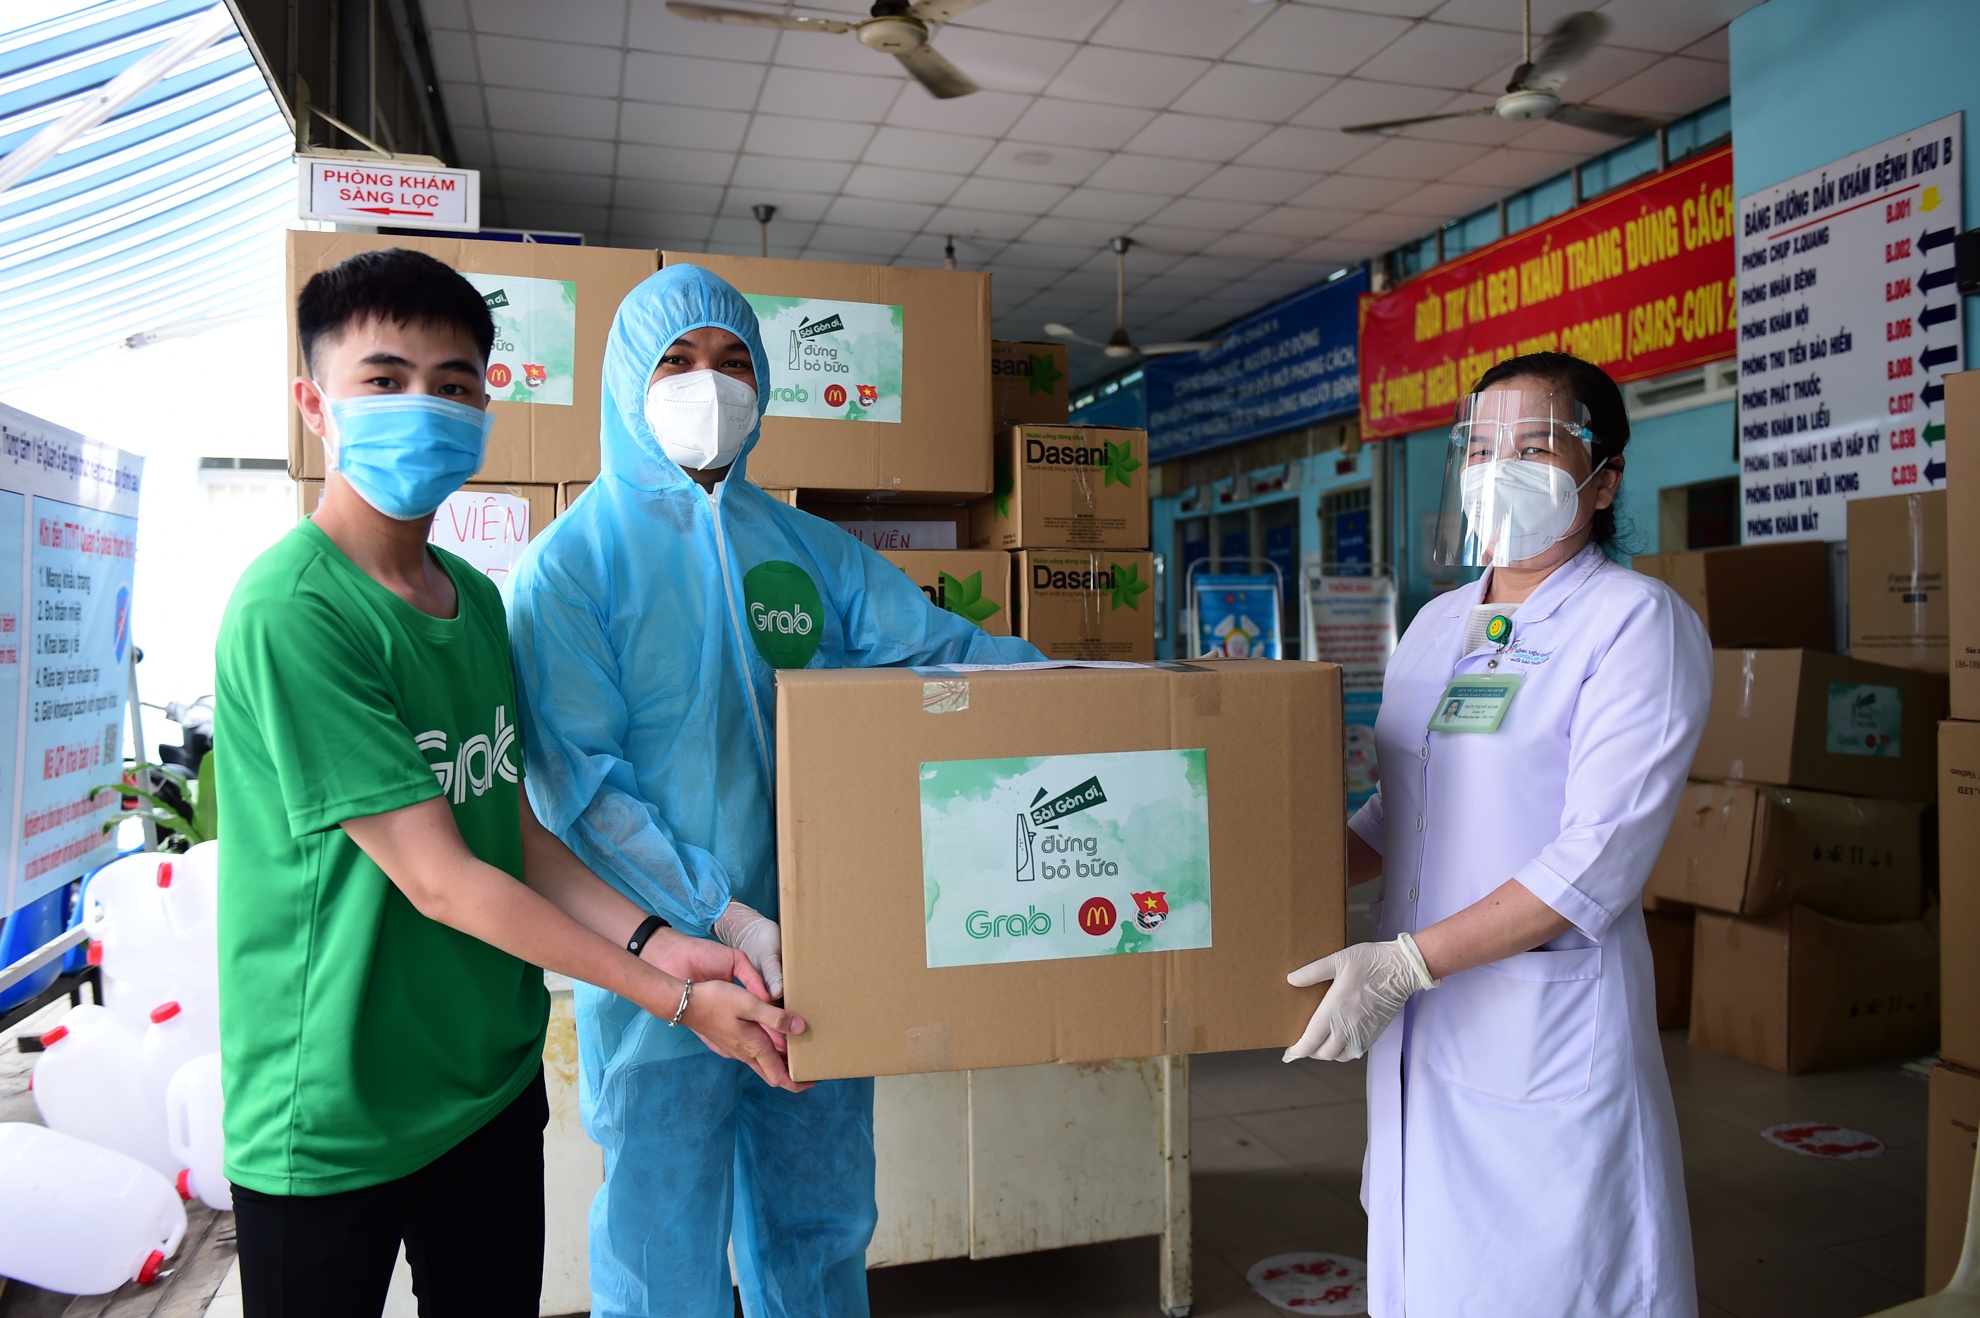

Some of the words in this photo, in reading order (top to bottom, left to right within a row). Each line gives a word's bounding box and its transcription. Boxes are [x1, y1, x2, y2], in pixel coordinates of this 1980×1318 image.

[324, 166, 394, 187] PHÒNG
[400, 173, 456, 191] KHÁM
[1745, 202, 1771, 238] BẢNG
[1813, 172, 1835, 212] DẪN
[1839, 164, 1871, 202] KHÁM
[1875, 153, 1907, 191] BỆNH
[1912, 140, 1939, 176] KHU
[1943, 136, 1953, 165] B
[339, 185, 394, 204] SÀNG
[401, 193, 440, 210] LỌC
[1487, 264, 1518, 318] ĐEO
[1520, 235, 1563, 308] KHẨU
[1565, 227, 1622, 293] TRANG
[1625, 204, 1679, 272] ĐÚNG
[1683, 181, 1735, 252] CÁCH
[1742, 249, 1767, 272] PHÒNG
[1770, 240, 1790, 265] CHỤP
[1886, 197, 1911, 224] B.001
[1742, 284, 1767, 307] PHÒNG
[1795, 267, 1817, 295] BỆNH
[1886, 238, 1911, 263] B.002
[1742, 317, 1767, 340] PHÒNG
[1770, 308, 1792, 333] KHÁM
[1886, 277, 1911, 303] B.004
[800, 327, 814, 338] Sài
[813, 322, 831, 334] Gòn
[804, 344, 838, 360] đừng
[1742, 355, 1767, 378] PHÒNG
[1770, 351, 1785, 370] THU
[1887, 317, 1912, 341] B.006
[804, 360, 821, 371] bỏ
[824, 361, 849, 374] bữa
[1742, 389, 1768, 412] PHÒNG
[1770, 381, 1790, 406] PHÁT
[1888, 356, 1913, 380] B.008
[769, 384, 809, 403] rab
[1743, 423, 1768, 444] PHÒNG
[1771, 414, 1794, 438] KHÁM
[1797, 412, 1808, 433] DA
[1888, 392, 1914, 416] C.037
[1026, 439, 1109, 466] Dasani
[1745, 453, 1769, 474] PHÒNG
[1821, 443, 1827, 461] &
[1890, 428, 1916, 450] C.038
[1746, 486, 1771, 505] PHÒNG
[1774, 477, 1796, 500] KHÁM
[1799, 482, 1812, 498] TAI
[1835, 472, 1859, 499] HỌNG
[1747, 517, 1773, 538] PHÒNG
[1776, 509, 1798, 534] KHÁM
[1033, 565, 1116, 589] Dasani
[750, 601, 813, 636] Grab
[414, 705, 518, 804] Grab
[1032, 806, 1056, 826] Sài
[1055, 793, 1084, 814] Gòn
[1084, 784, 1103, 803] ơi,
[1041, 833, 1098, 857] đừng
[1042, 858, 1071, 880] bỏ
[1075, 857, 1119, 878] bữa
[965, 905, 1052, 939] Grab
